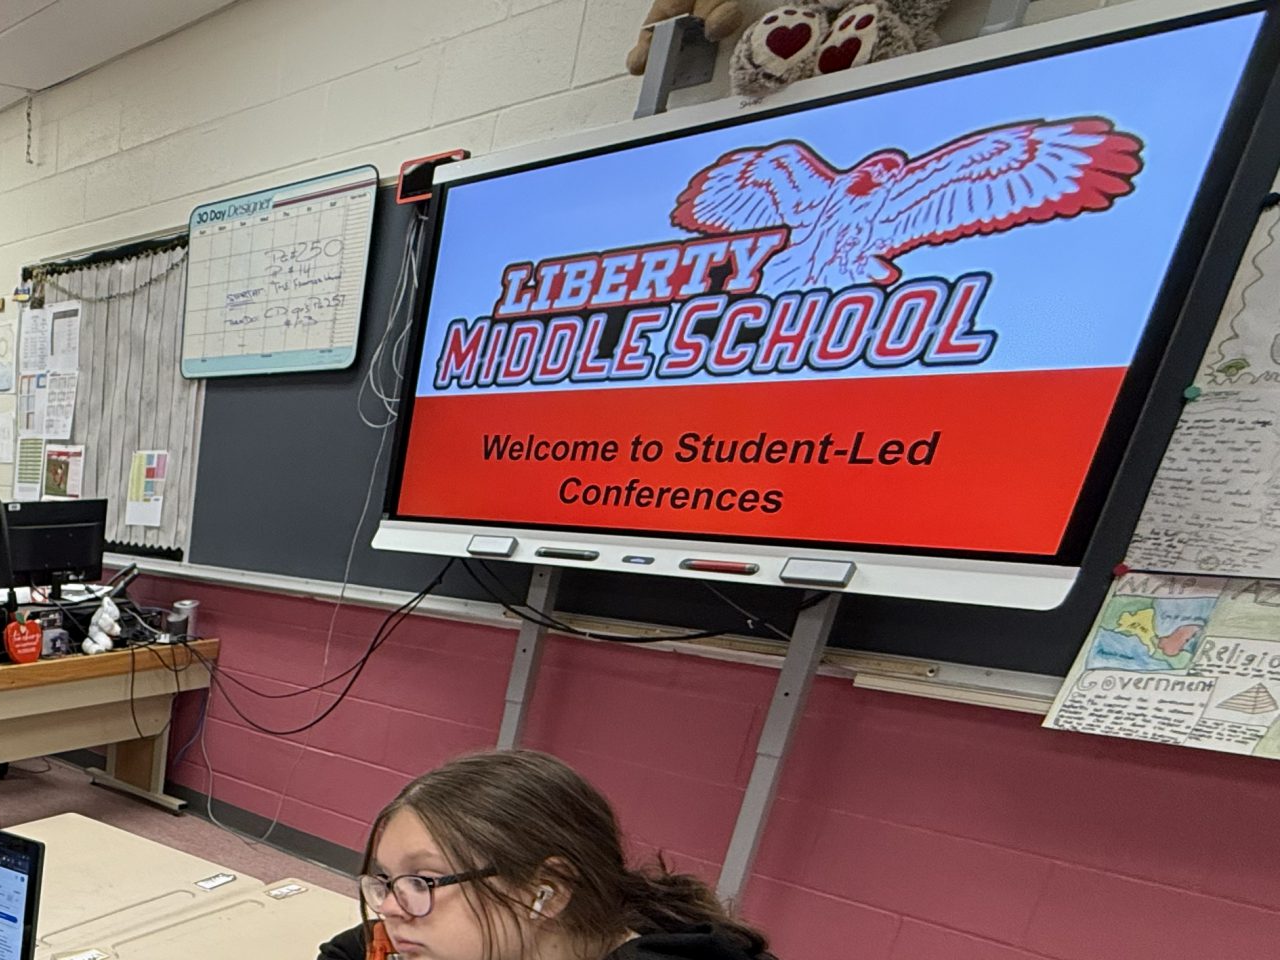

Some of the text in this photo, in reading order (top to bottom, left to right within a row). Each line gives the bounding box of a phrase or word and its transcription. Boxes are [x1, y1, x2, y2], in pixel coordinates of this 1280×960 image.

[196, 197, 272, 224] 30 Day Designer
[495, 229, 788, 317] LIBERTY
[435, 273, 996, 388] MIDDLE SCHOOL
[482, 431, 942, 466] Welcome to Student-Led
[558, 476, 785, 513] Conferences
[1119, 576, 1198, 594] MAP
[1077, 671, 1215, 692] Government
